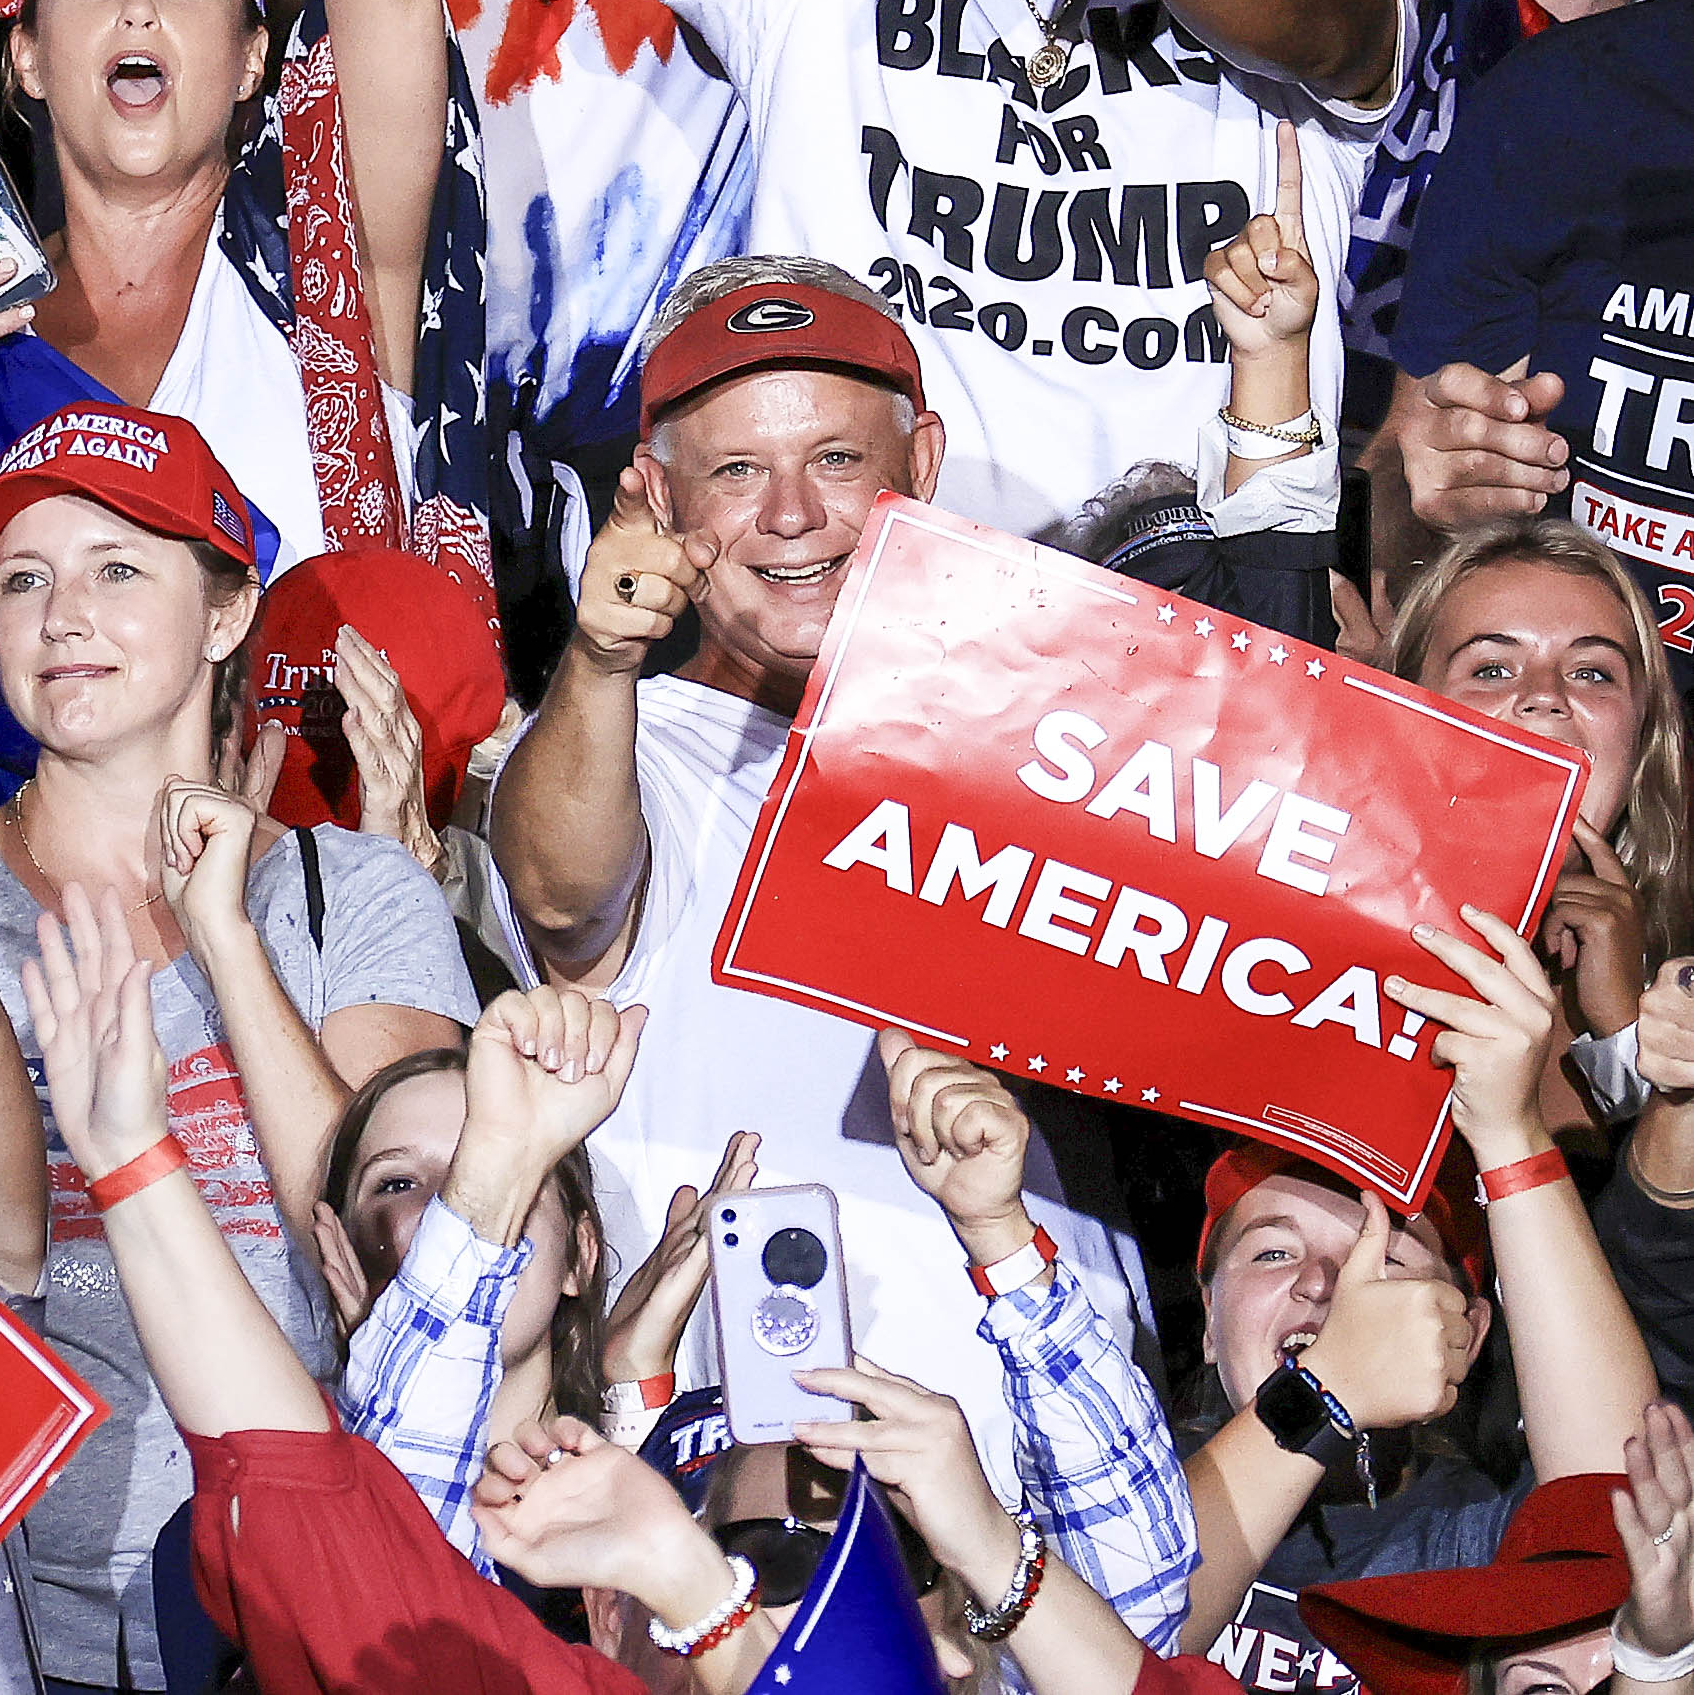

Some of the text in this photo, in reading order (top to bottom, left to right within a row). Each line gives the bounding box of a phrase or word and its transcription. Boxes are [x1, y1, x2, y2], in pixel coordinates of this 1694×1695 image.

[996, 103, 1110, 177] FOR
[860, 124, 1251, 290] TRUMP
[1602, 283, 1694, 338] AM
[46, 413, 169, 455] AMERICA
[1588, 356, 1694, 472] TR
[66, 433, 158, 474] AGAIN
[1585, 495, 1694, 563] TAKE A
[1657, 584, 1694, 654] 2
[263, 654, 335, 690] Tru
[1017, 707, 1353, 899] SAVE
[822, 798, 1427, 1062] AMERICA!
[670, 1414, 734, 1467] TR
